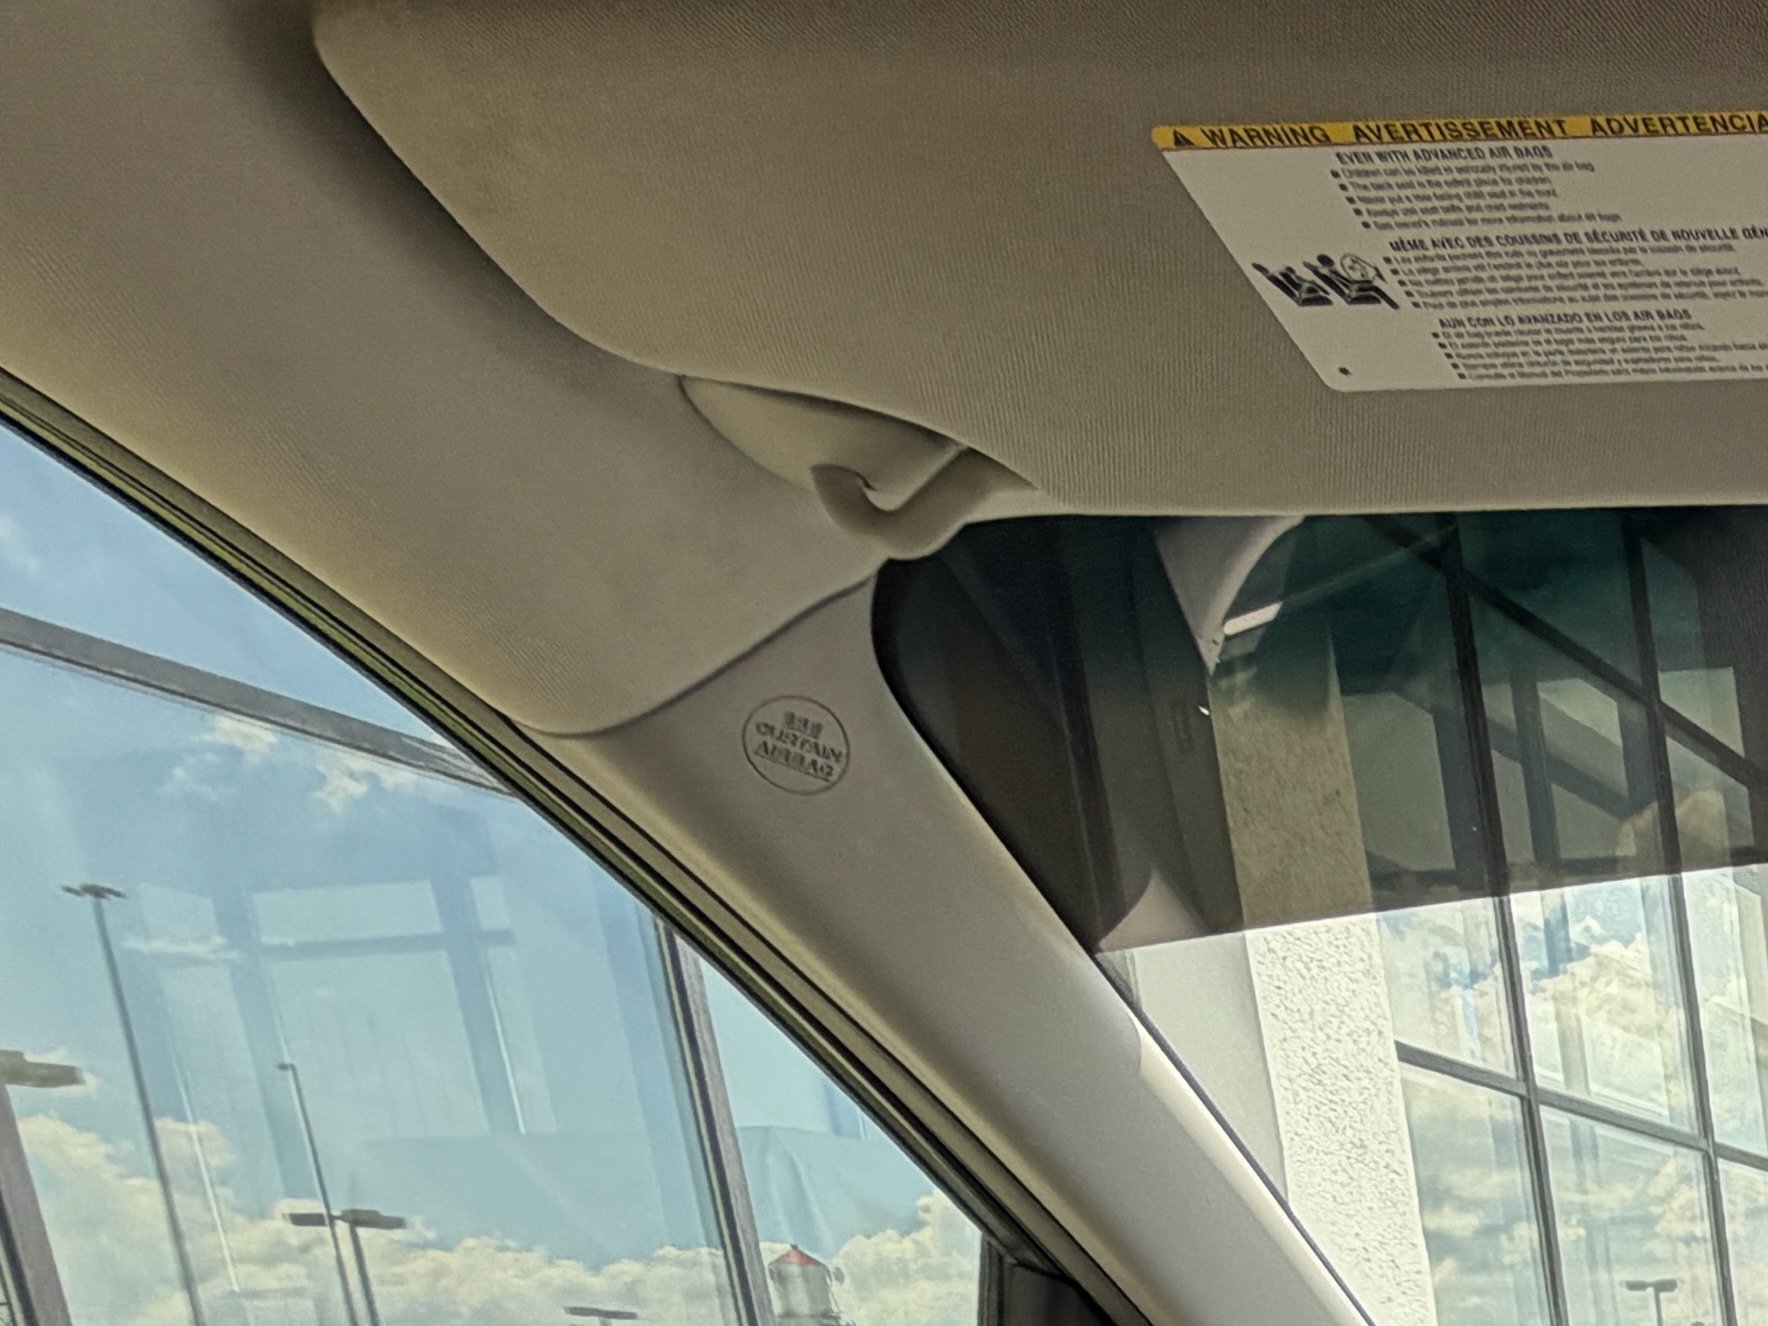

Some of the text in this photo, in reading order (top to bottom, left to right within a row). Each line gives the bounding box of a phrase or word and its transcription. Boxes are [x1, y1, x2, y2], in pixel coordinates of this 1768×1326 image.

[1203, 123, 1331, 149] WARNING
[1353, 118, 1567, 145] AVERTISSEMENT
[1336, 152, 1374, 165] EVEN
[1376, 150, 1410, 163] WITH
[1413, 147, 1486, 162] ADVANCED
[1489, 147, 1515, 159] AIR
[1431, 238, 1463, 249] AVEC
[1466, 236, 1494, 248] DES
[1496, 232, 1562, 247] COUSSINS
[1564, 231, 1582, 244] DE
[1584, 227, 1647, 243] SÉCURITÉ
[1650, 228, 1669, 241] DE
[1671, 227, 1740, 241] NOUVELLE
[1467, 316, 1496, 328] CON
[1497, 315, 1516, 327] LO
[1517, 312, 1583, 325] AVANZADO
[1584, 311, 1603, 323] EN
[1604, 309, 1632, 322] LOS
